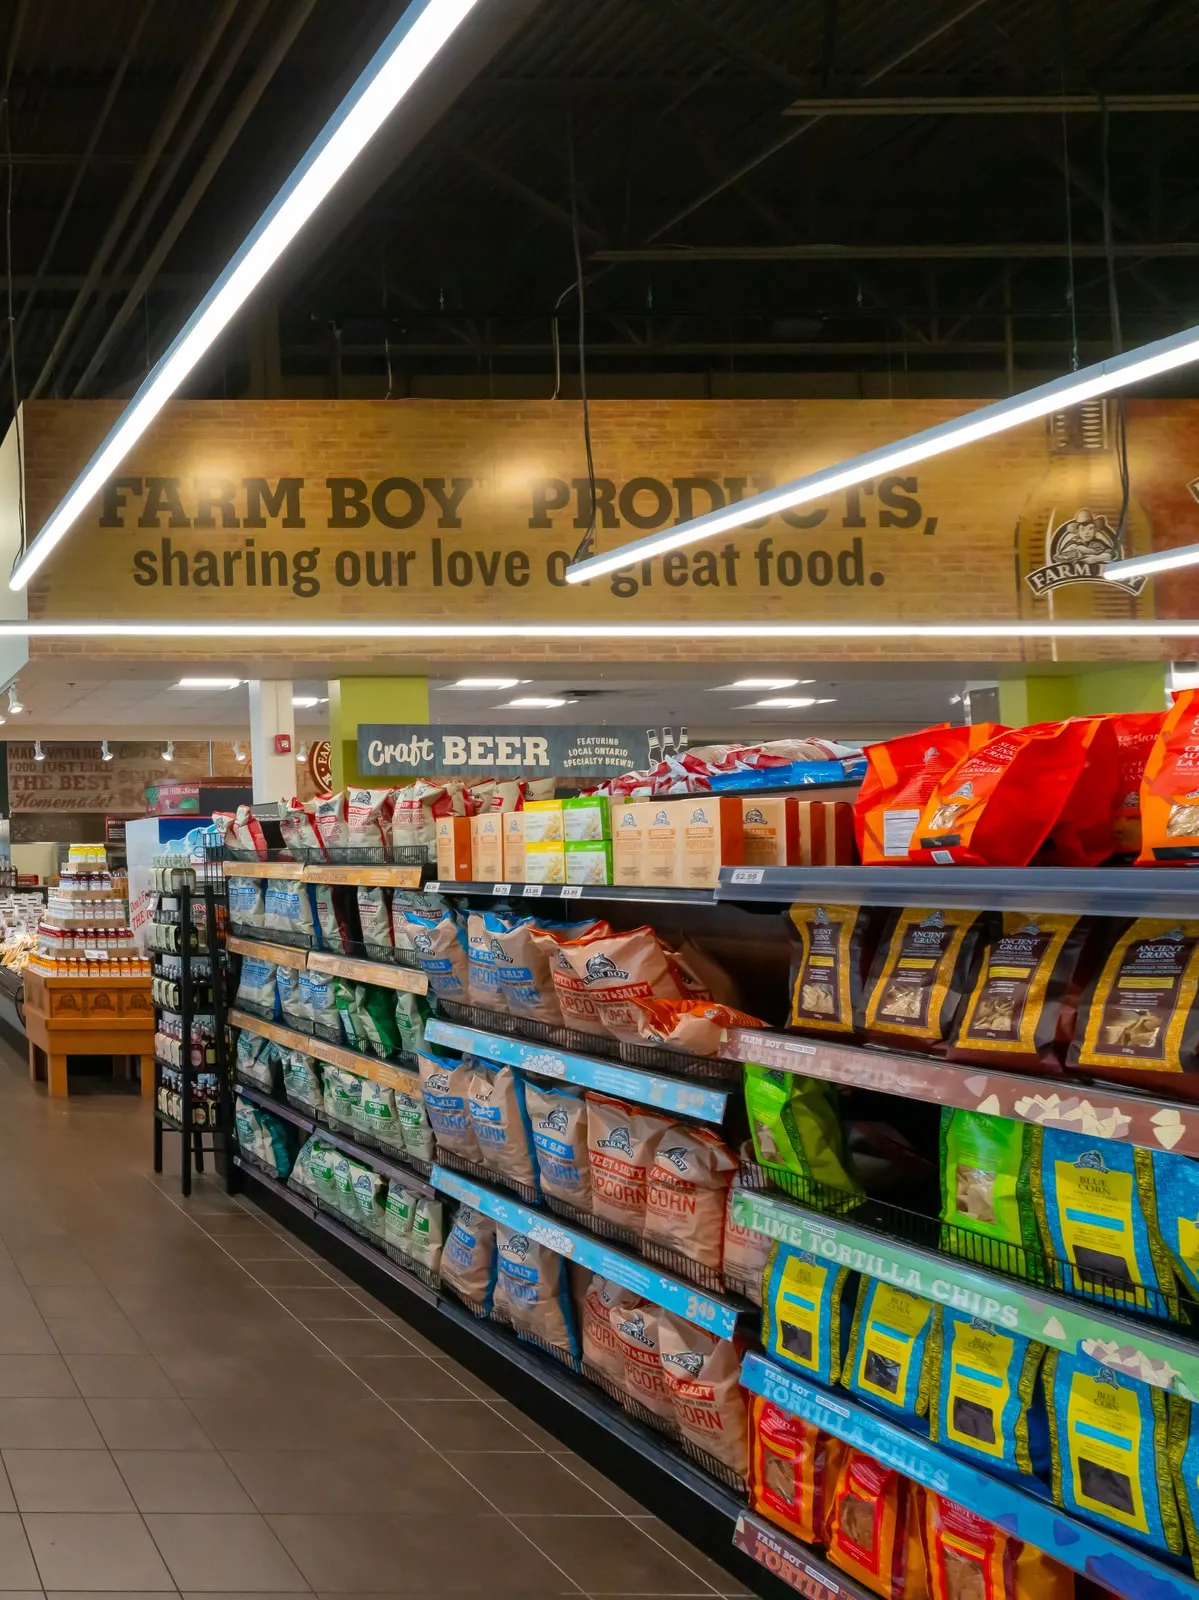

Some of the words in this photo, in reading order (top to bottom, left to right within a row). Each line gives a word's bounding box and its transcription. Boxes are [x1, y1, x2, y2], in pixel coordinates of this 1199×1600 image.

[100, 477, 306, 528] FARM
[326, 476, 471, 529] BOY
[133, 538, 321, 598] sharing
[334, 549, 416, 587] our
[431, 538, 531, 588] love
[609, 543, 740, 598] great
[754, 537, 886, 587] food.
[1031, 563, 1091, 590] FARM
[576, 737, 620, 747] FEATURING
[9, 747, 35, 761] MAD
[367, 734, 435, 767] Craft
[442, 735, 550, 766] BEER
[568, 748, 593, 758] LOCAL
[594, 747, 629, 757] ONTARIO
[42, 761, 75, 773] JUST
[563, 756, 604, 768] SPECIALTY
[605, 757, 635, 769] BREWS!
[10, 774, 54, 791] THE
[59, 774, 113, 791] BEST
[10, 792, 114, 809] Homemade!
[735, 872, 757, 881] $2.99
[1139, 951, 1175, 959] GRAINS
[583, 972, 604, 986] FARM
[607, 970, 628, 979] BOY
[740, 1035, 762, 1047] FARM
[764, 1039, 781, 1049] BOY
[598, 1140, 622, 1149] FARM
[623, 1145, 634, 1158] BOY
[670, 1154, 688, 1171] BOY
[1078, 1183, 1111, 1196] CORN
[1079, 1176, 1109, 1188] BLUE
[509, 1263, 532, 1278] SALT
[752, 1212, 803, 1245] LIME
[809, 1233, 923, 1291] TORTILLA
[931, 1279, 1020, 1329] CHIPS
[635, 1330, 655, 1348] BOY
[764, 1368, 791, 1389] FARM
[791, 1382, 811, 1398] BOY
[1096, 1390, 1117, 1402] BLUE
[1093, 1397, 1120, 1412] CORN
[763, 1380, 864, 1446] TORTILLA
[871, 1438, 950, 1493] CHIPS
[757, 1532, 783, 1555] FARM
[783, 1551, 801, 1567] BOY
